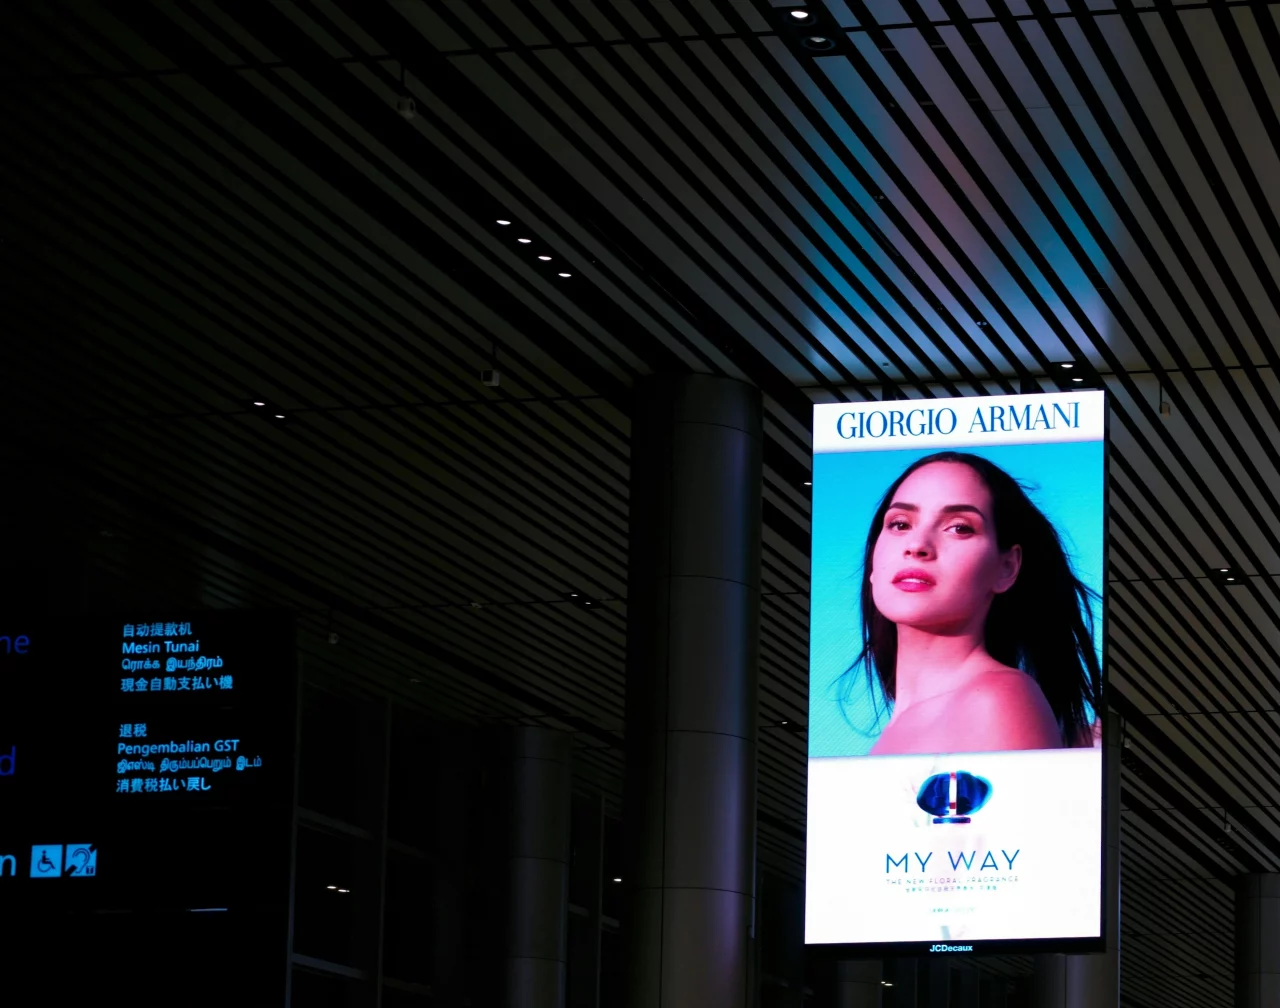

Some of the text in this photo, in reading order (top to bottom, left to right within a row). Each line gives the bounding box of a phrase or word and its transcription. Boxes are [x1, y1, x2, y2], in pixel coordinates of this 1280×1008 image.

[837, 402, 1080, 439] GIORGIO ARMANI
[123, 622, 192, 637] 自动提款机
[122, 640, 200, 654] Mesin Tunai
[120, 675, 233, 692] 現金自動支払い機
[119, 723, 147, 737] 退税
[117, 739, 240, 757] Pengembalian GST
[886, 849, 1020, 874] MY WAY
[929, 943, 973, 952] JCDecaux
